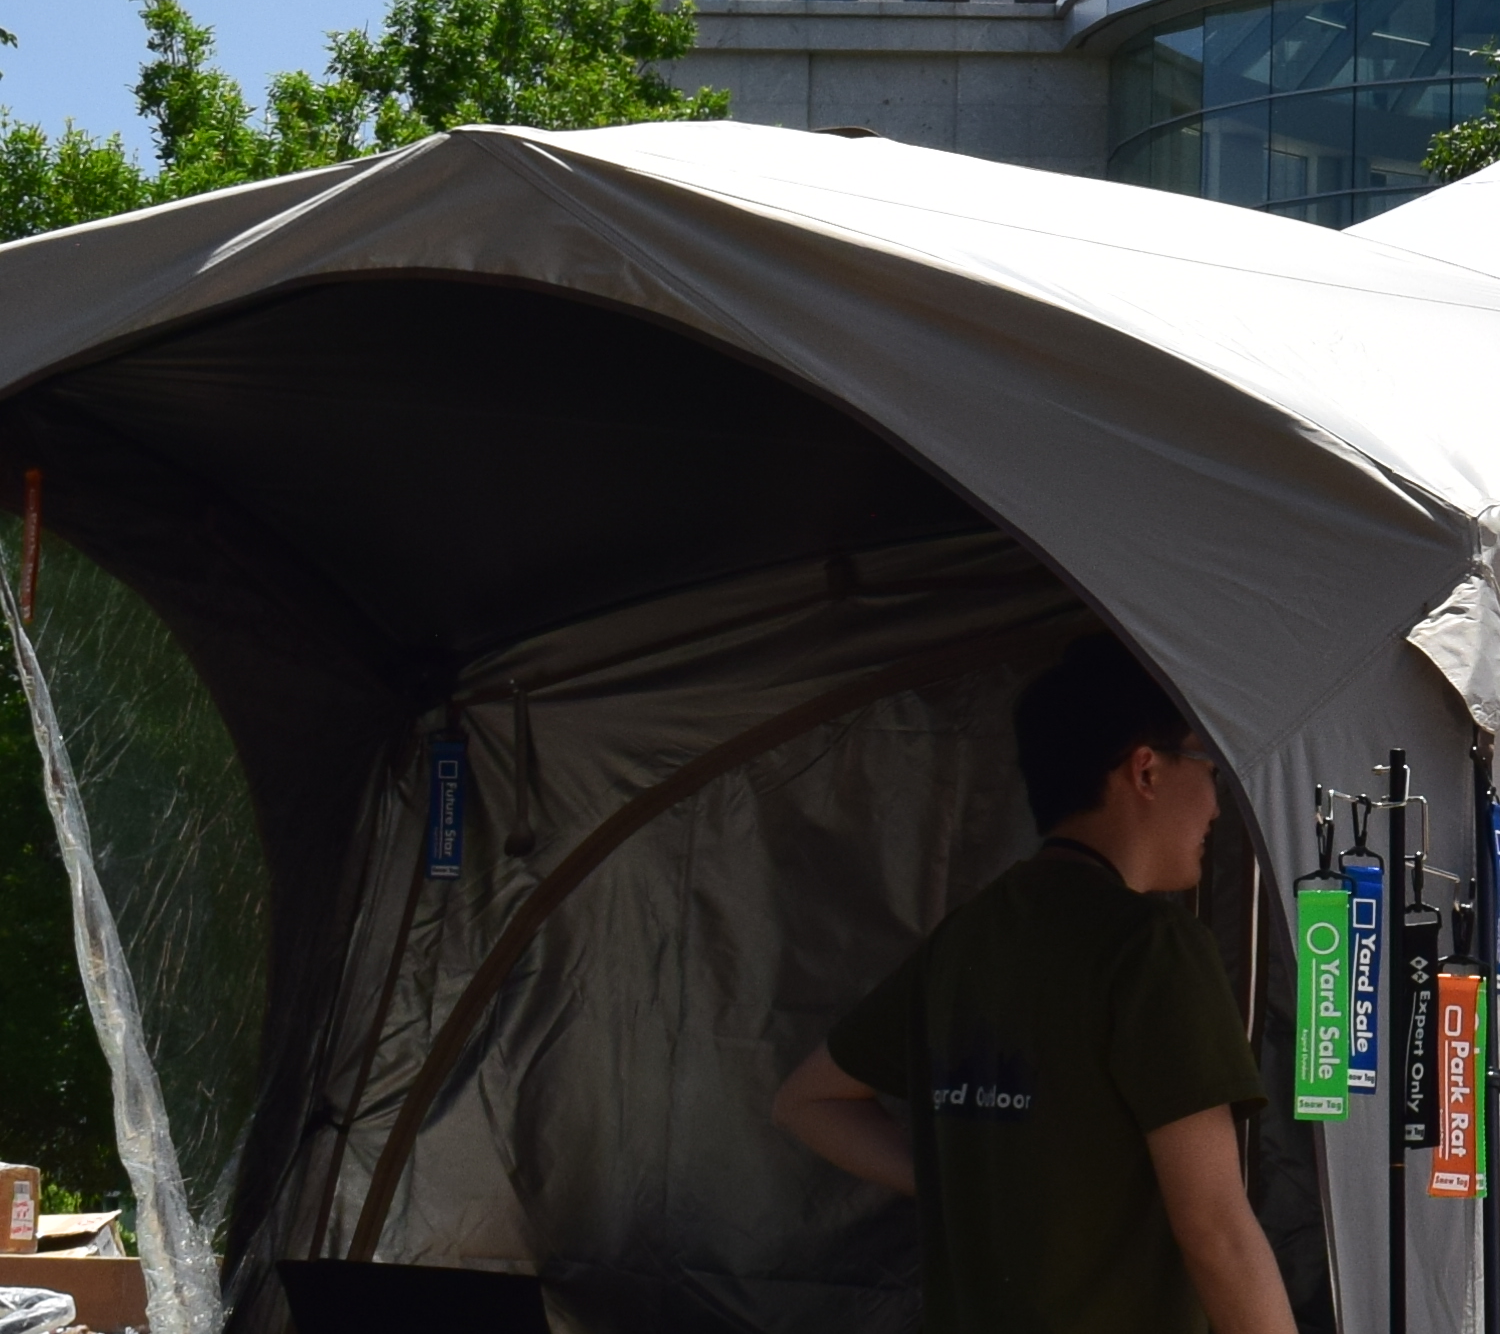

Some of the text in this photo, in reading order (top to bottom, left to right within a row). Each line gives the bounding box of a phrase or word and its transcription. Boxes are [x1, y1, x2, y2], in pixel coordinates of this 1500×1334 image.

[444, 781, 458, 857] Future Star
[1318, 958, 1341, 1080] Yard Sale
[1357, 933, 1377, 1054] Yard Sale
[1413, 990, 1432, 1058] Expert
[1298, 1098, 1344, 1112] Snow Tag
[1408, 1062, 1425, 1114] Only
[1450, 1040, 1470, 1158] Park Rat
[1435, 1175, 1469, 1189] Snow Tag
